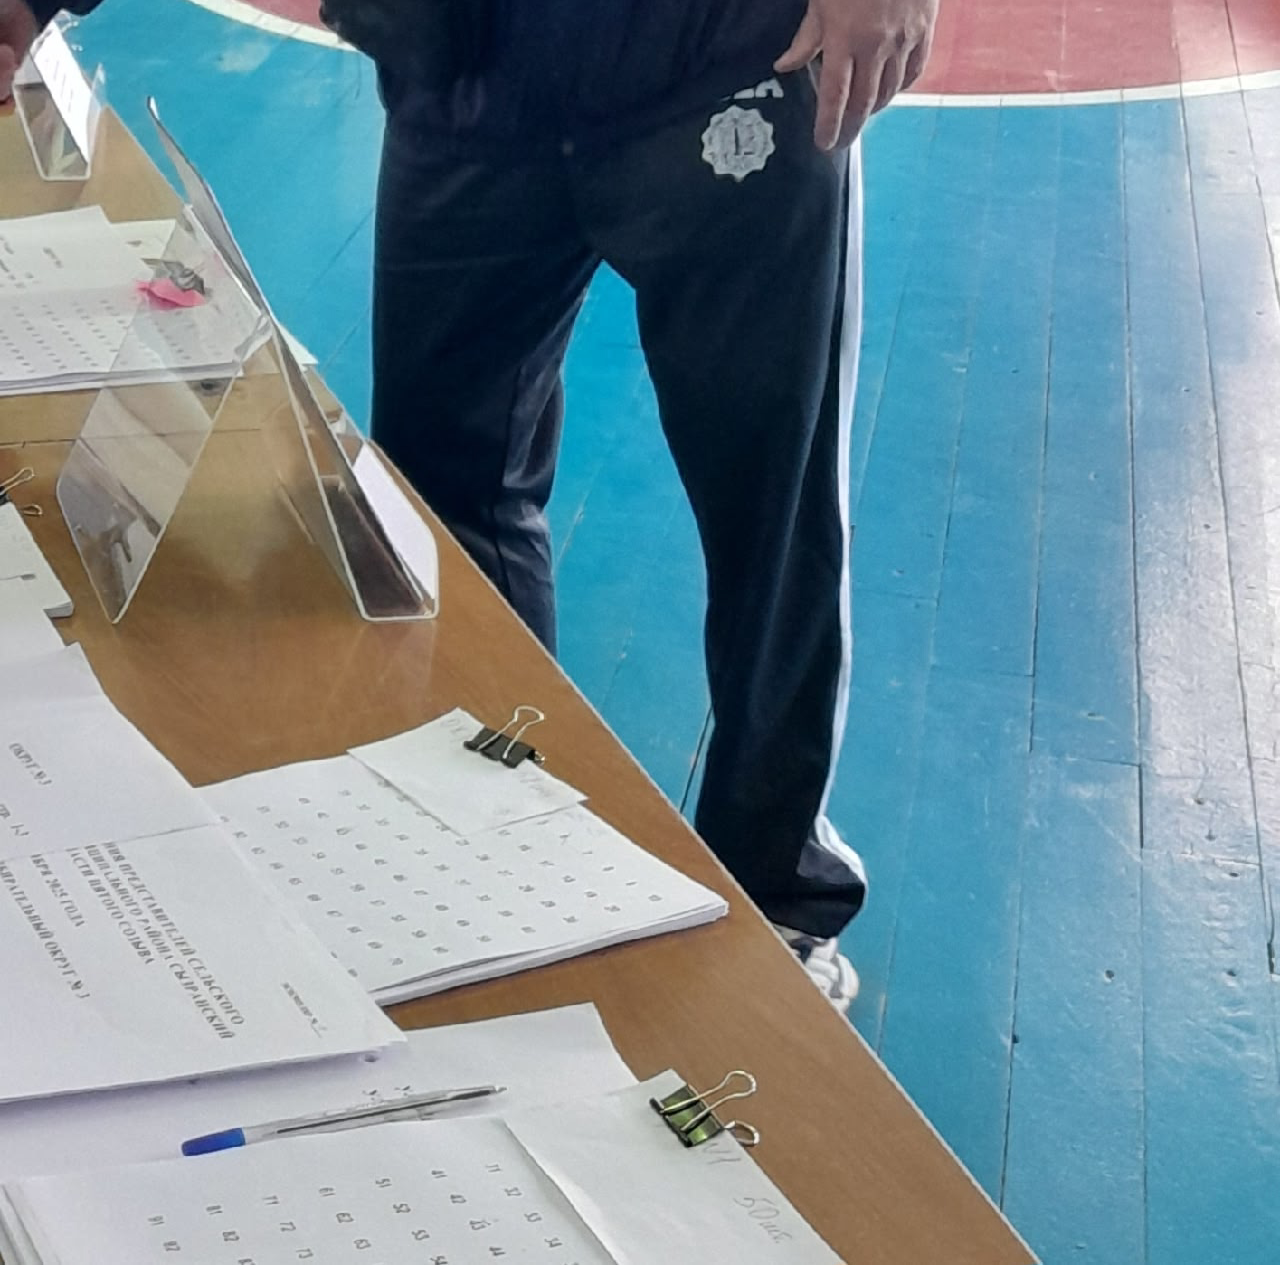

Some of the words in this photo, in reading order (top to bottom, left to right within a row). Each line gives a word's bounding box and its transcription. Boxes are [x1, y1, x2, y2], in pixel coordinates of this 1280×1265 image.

[44, 877, 69, 900] 2025
[59, 898, 86, 928] ГОДА
[87, 878, 126, 921] ПЯТОГО
[118, 920, 156, 965] СОЗЫВА
[43, 940, 78, 976] ОКРУГ
[119, 862, 197, 956] ПРЕДСТАВИТЕЛЕЙ
[186, 955, 245, 1026] СЕЛЬСКОГО
[135, 917, 175, 962] РАЙОНА
[168, 961, 237, 1040] СЫЗРАНСКИЙ
[148, 1215, 165, 1226] 91
[206, 1205, 223, 1215] 81
[222, 1230, 240, 1242] 82
[264, 1195, 279, 1205] 71
[279, 1221, 297, 1232] 72
[295, 1248, 314, 1259] 73
[318, 1187, 335, 1197] 61
[335, 1212, 354, 1224] 62
[353, 1238, 372, 1250] 63
[375, 1178, 392, 1188] 51
[392, 1203, 411, 1214] 52
[411, 1229, 430, 1241] 53
[431, 1170, 447, 1179] 41
[450, 1194, 467, 1204] 42
[489, 1246, 506, 1257] 44
[544, 1237, 563, 1248] 34
